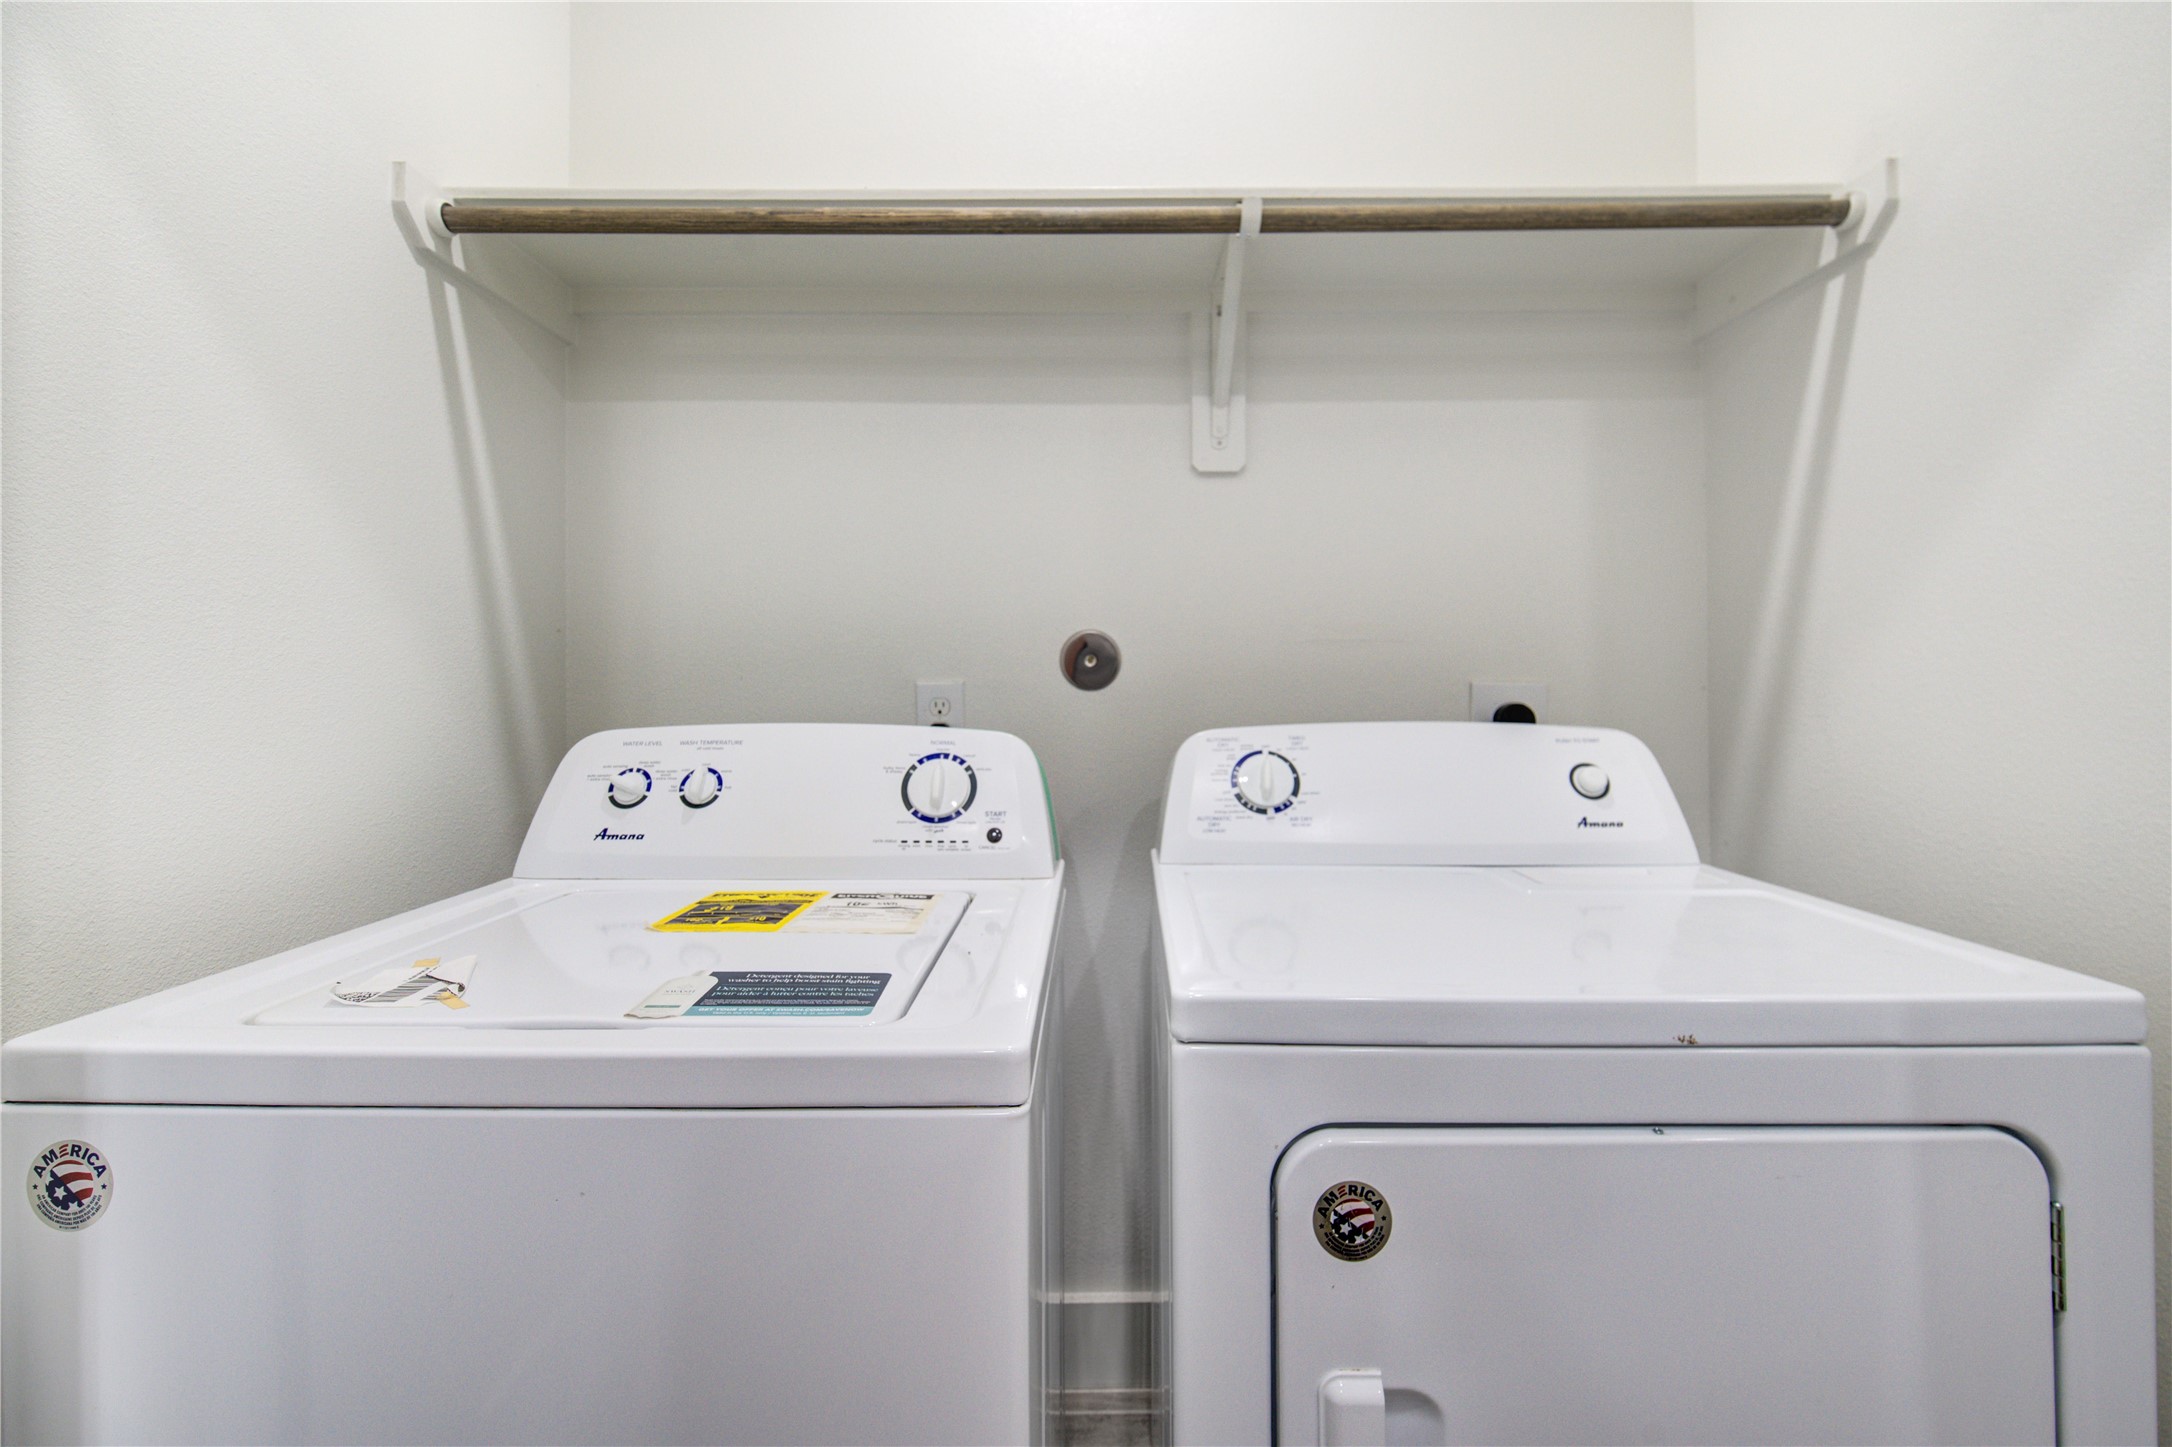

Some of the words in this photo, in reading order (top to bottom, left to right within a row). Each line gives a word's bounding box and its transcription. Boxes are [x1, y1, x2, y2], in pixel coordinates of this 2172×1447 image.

[593, 827, 645, 841] Amana
[1578, 816, 1623, 829] Amana
[33, 1143, 107, 1179] AMERICA
[1317, 1184, 1384, 1219] AMERICA
